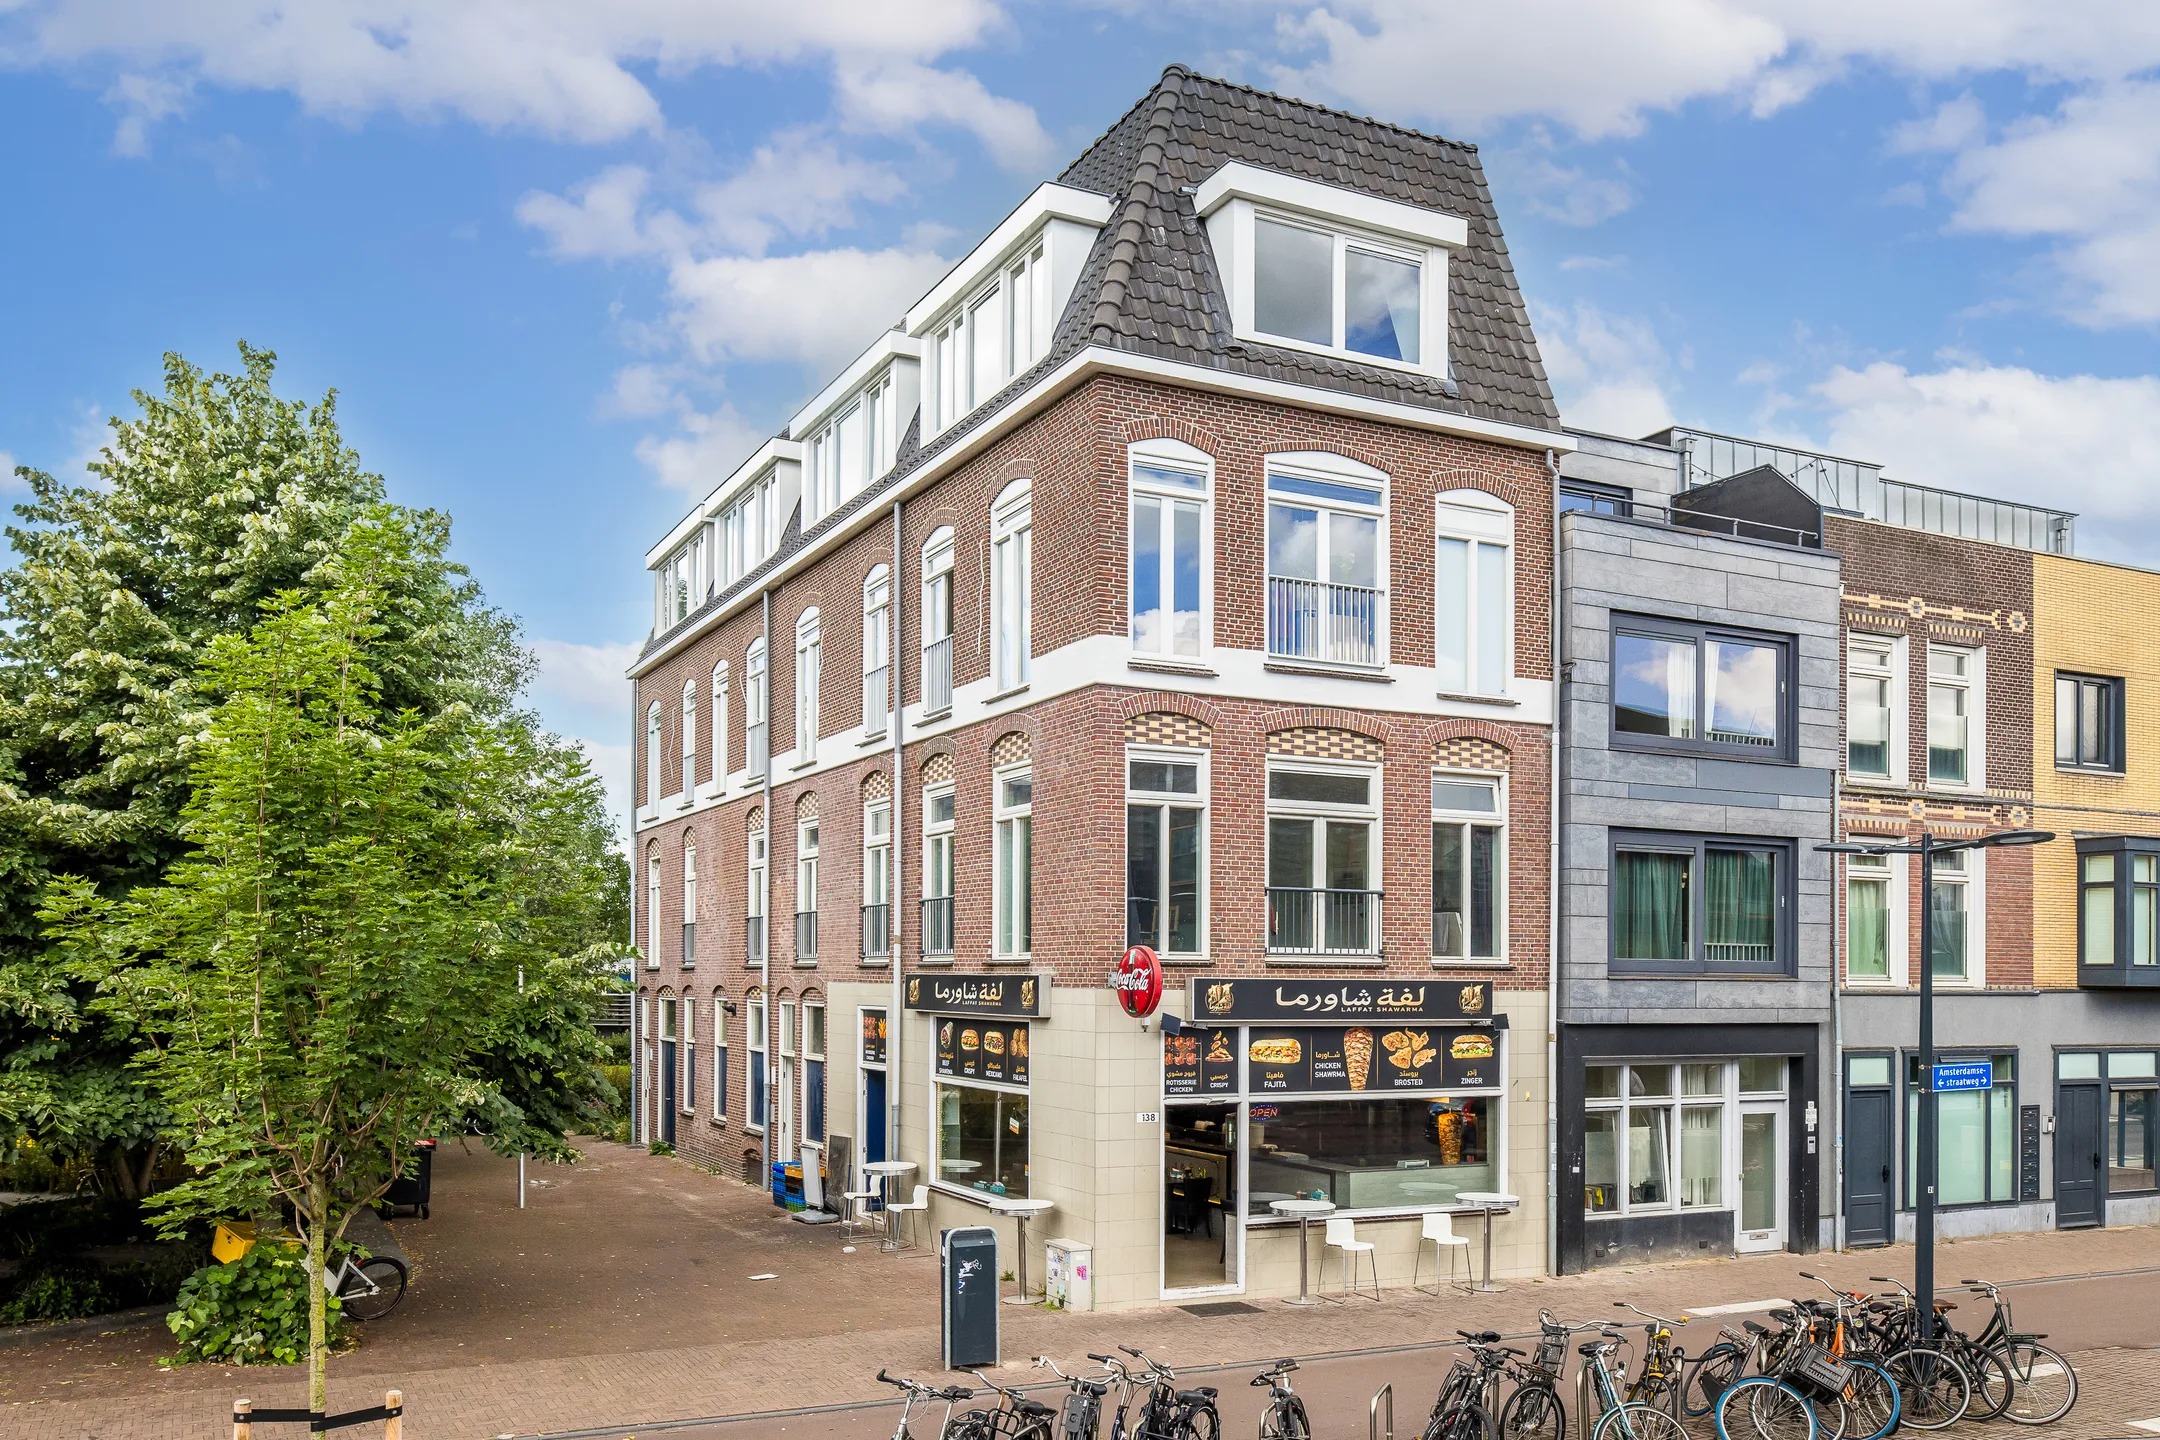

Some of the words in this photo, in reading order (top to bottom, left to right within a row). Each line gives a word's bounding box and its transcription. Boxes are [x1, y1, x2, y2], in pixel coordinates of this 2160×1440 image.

[935, 981, 977, 1004] شاورما
[979, 981, 1003, 1001] لفة
[1275, 986, 1372, 1012] شاورما
[1377, 986, 1425, 1007] لفة
[1315, 1050, 1341, 1060] شاورما
[1314, 1070, 1346, 1078] SHAWRMA
[1938, 1067, 1986, 1076] Amsterdamse-
[1264, 1080, 1287, 1088] FAJITA
[1394, 1078, 1424, 1086] BROSTED
[1460, 1077, 1483, 1085] ZINGER
[1946, 1078, 1980, 1087] straatweg
[1249, 1108, 1278, 1117] OPEN
[1142, 1113, 1156, 1122] 138
